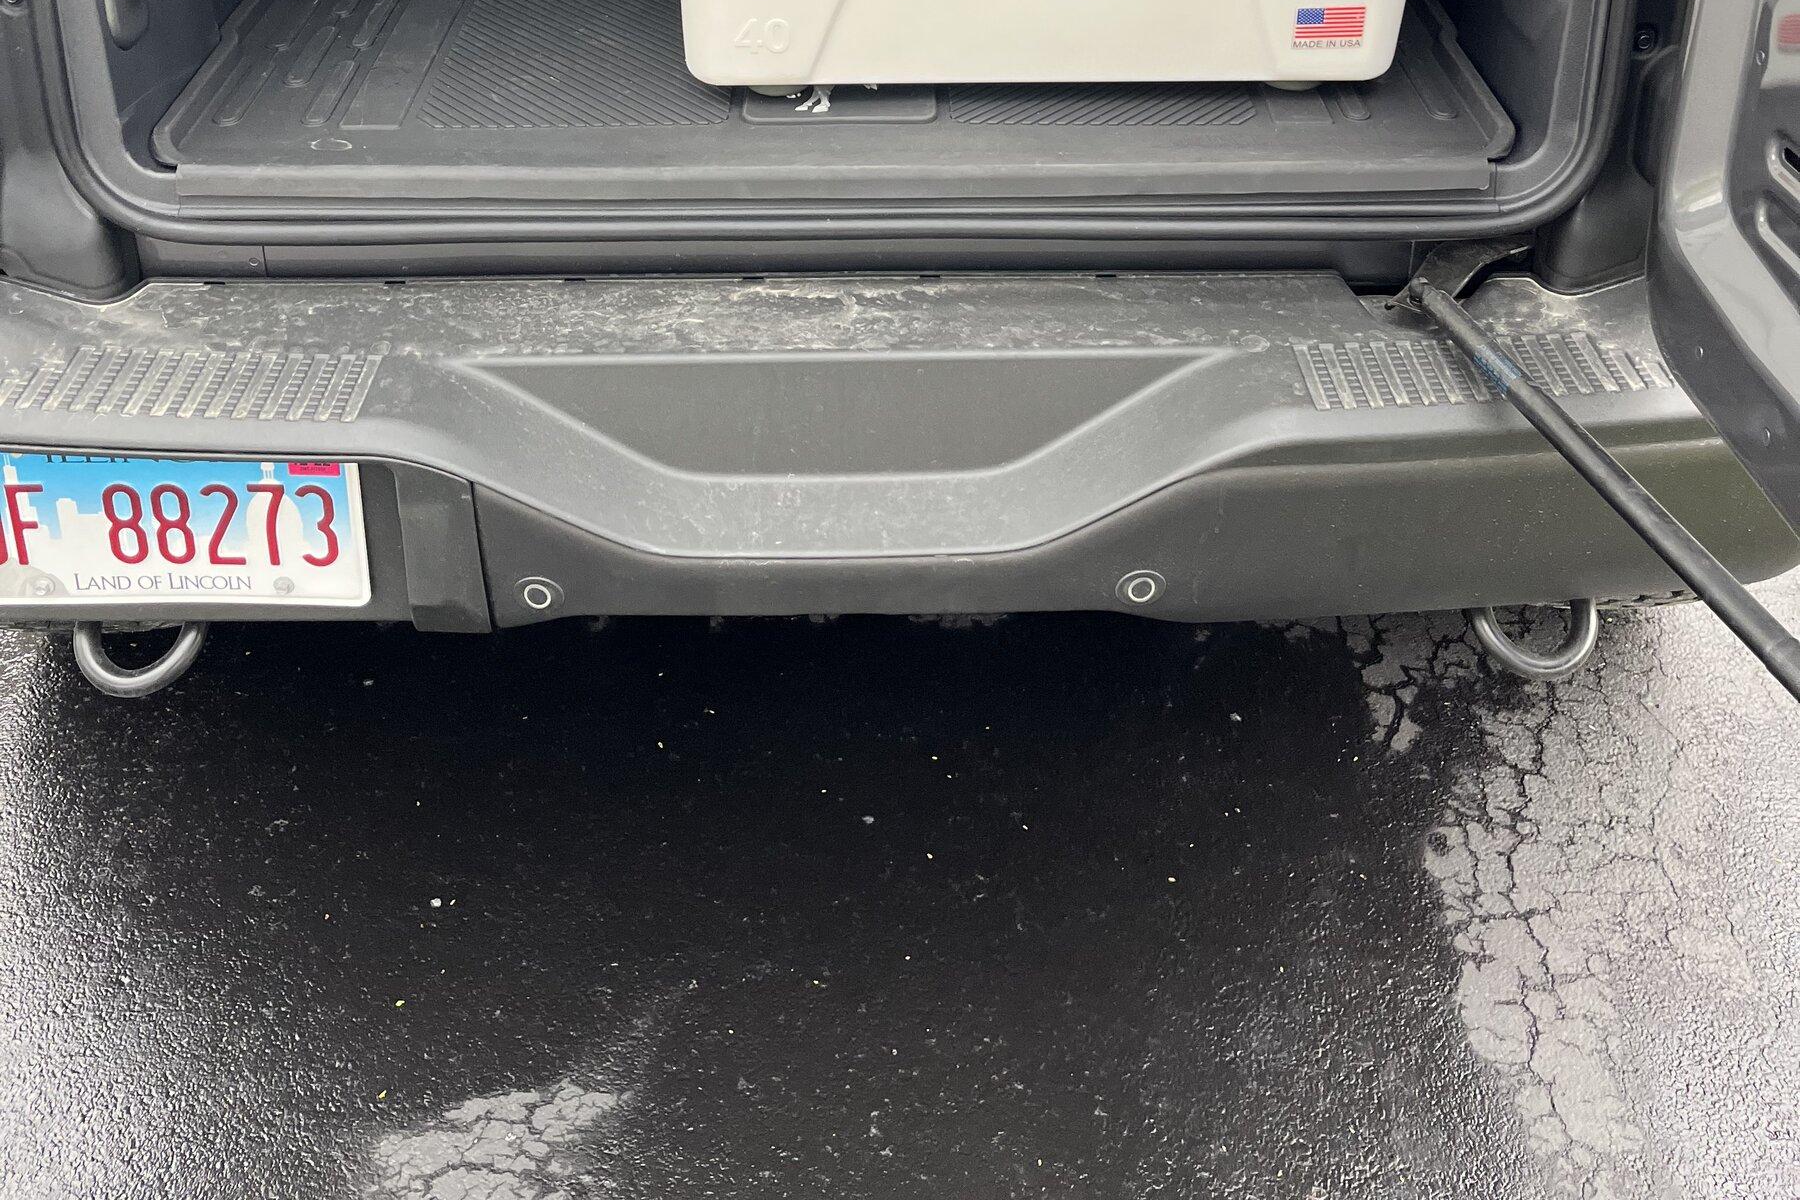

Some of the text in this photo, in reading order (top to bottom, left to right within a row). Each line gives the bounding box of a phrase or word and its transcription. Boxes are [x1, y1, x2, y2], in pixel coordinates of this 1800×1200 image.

[733, 17, 791, 55] 40
[1292, 39, 1361, 48] MADE IN USA
[101, 483, 340, 567] 88273
[74, 573, 252, 591] LAND OF LINCOLN
